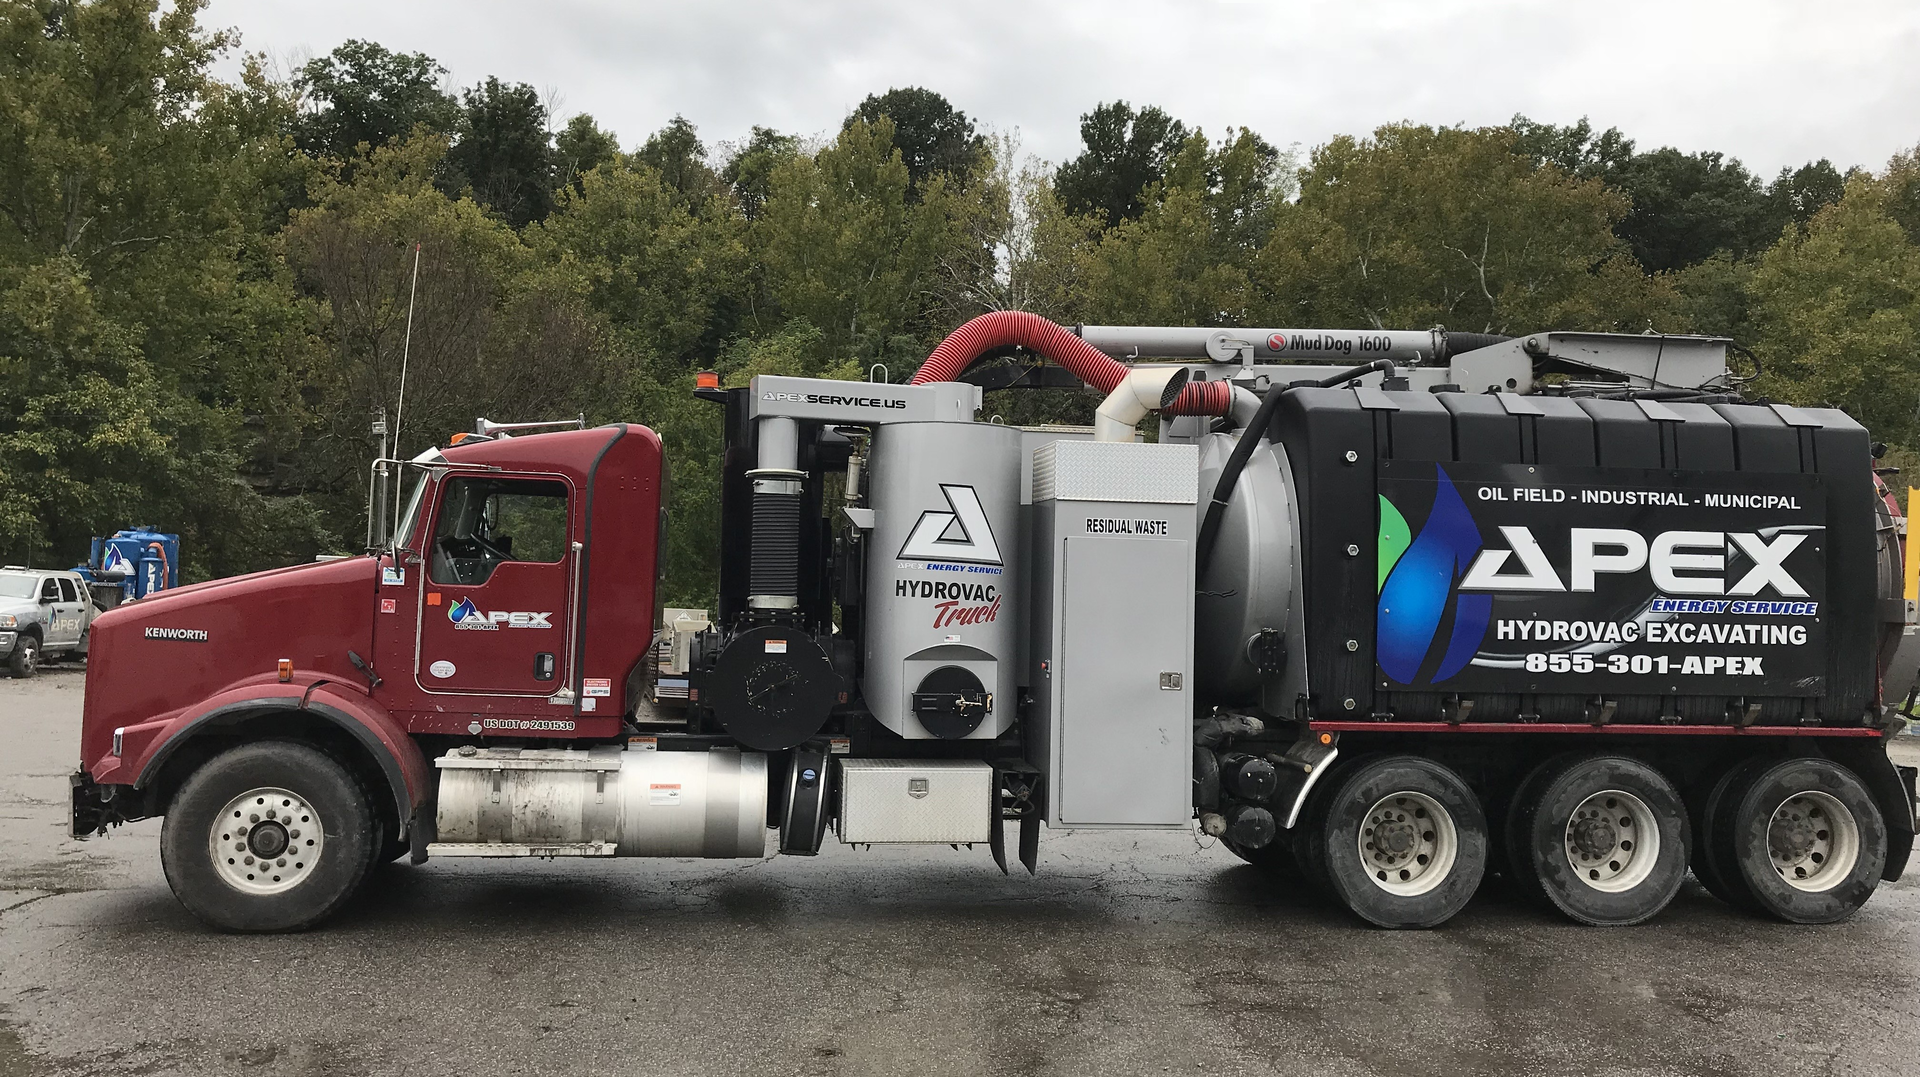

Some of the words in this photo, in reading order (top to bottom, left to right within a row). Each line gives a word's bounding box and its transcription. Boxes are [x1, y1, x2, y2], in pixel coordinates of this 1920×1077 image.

[1290, 334, 1321, 350] Mud
[1324, 335, 1352, 355] Dog
[1358, 336, 1391, 351] 1600
[1477, 486, 1508, 502] OIL
[1513, 487, 1566, 503] FIELD
[1581, 489, 1689, 507] INDUSTRIAL
[1704, 493, 1802, 510] MUNICIPAL
[1086, 518, 1132, 534] RESIDUAL
[1135, 520, 1167, 535] WASTE
[897, 562, 924, 570] APEX
[926, 563, 966, 572] ENERGY
[967, 565, 1003, 575] SERVICE
[1457, 525, 1811, 598] APEX
[895, 579, 996, 602] HYDROVAC
[933, 594, 1002, 629] Truck
[1650, 598, 1731, 614] ENERGY
[1731, 600, 1818, 616] SERVICE
[51, 618, 80, 632] APEX
[460, 610, 553, 626] APEX
[145, 627, 208, 640] KENWORTH
[1497, 619, 1640, 643] HYDROVAC
[1647, 622, 1807, 645] EXCAVATING
[1524, 652, 1765, 676] 855-301-APEX
[484, 718, 498, 729] US
[499, 719, 520, 730] DOT
[530, 720, 575, 731] 2491539
